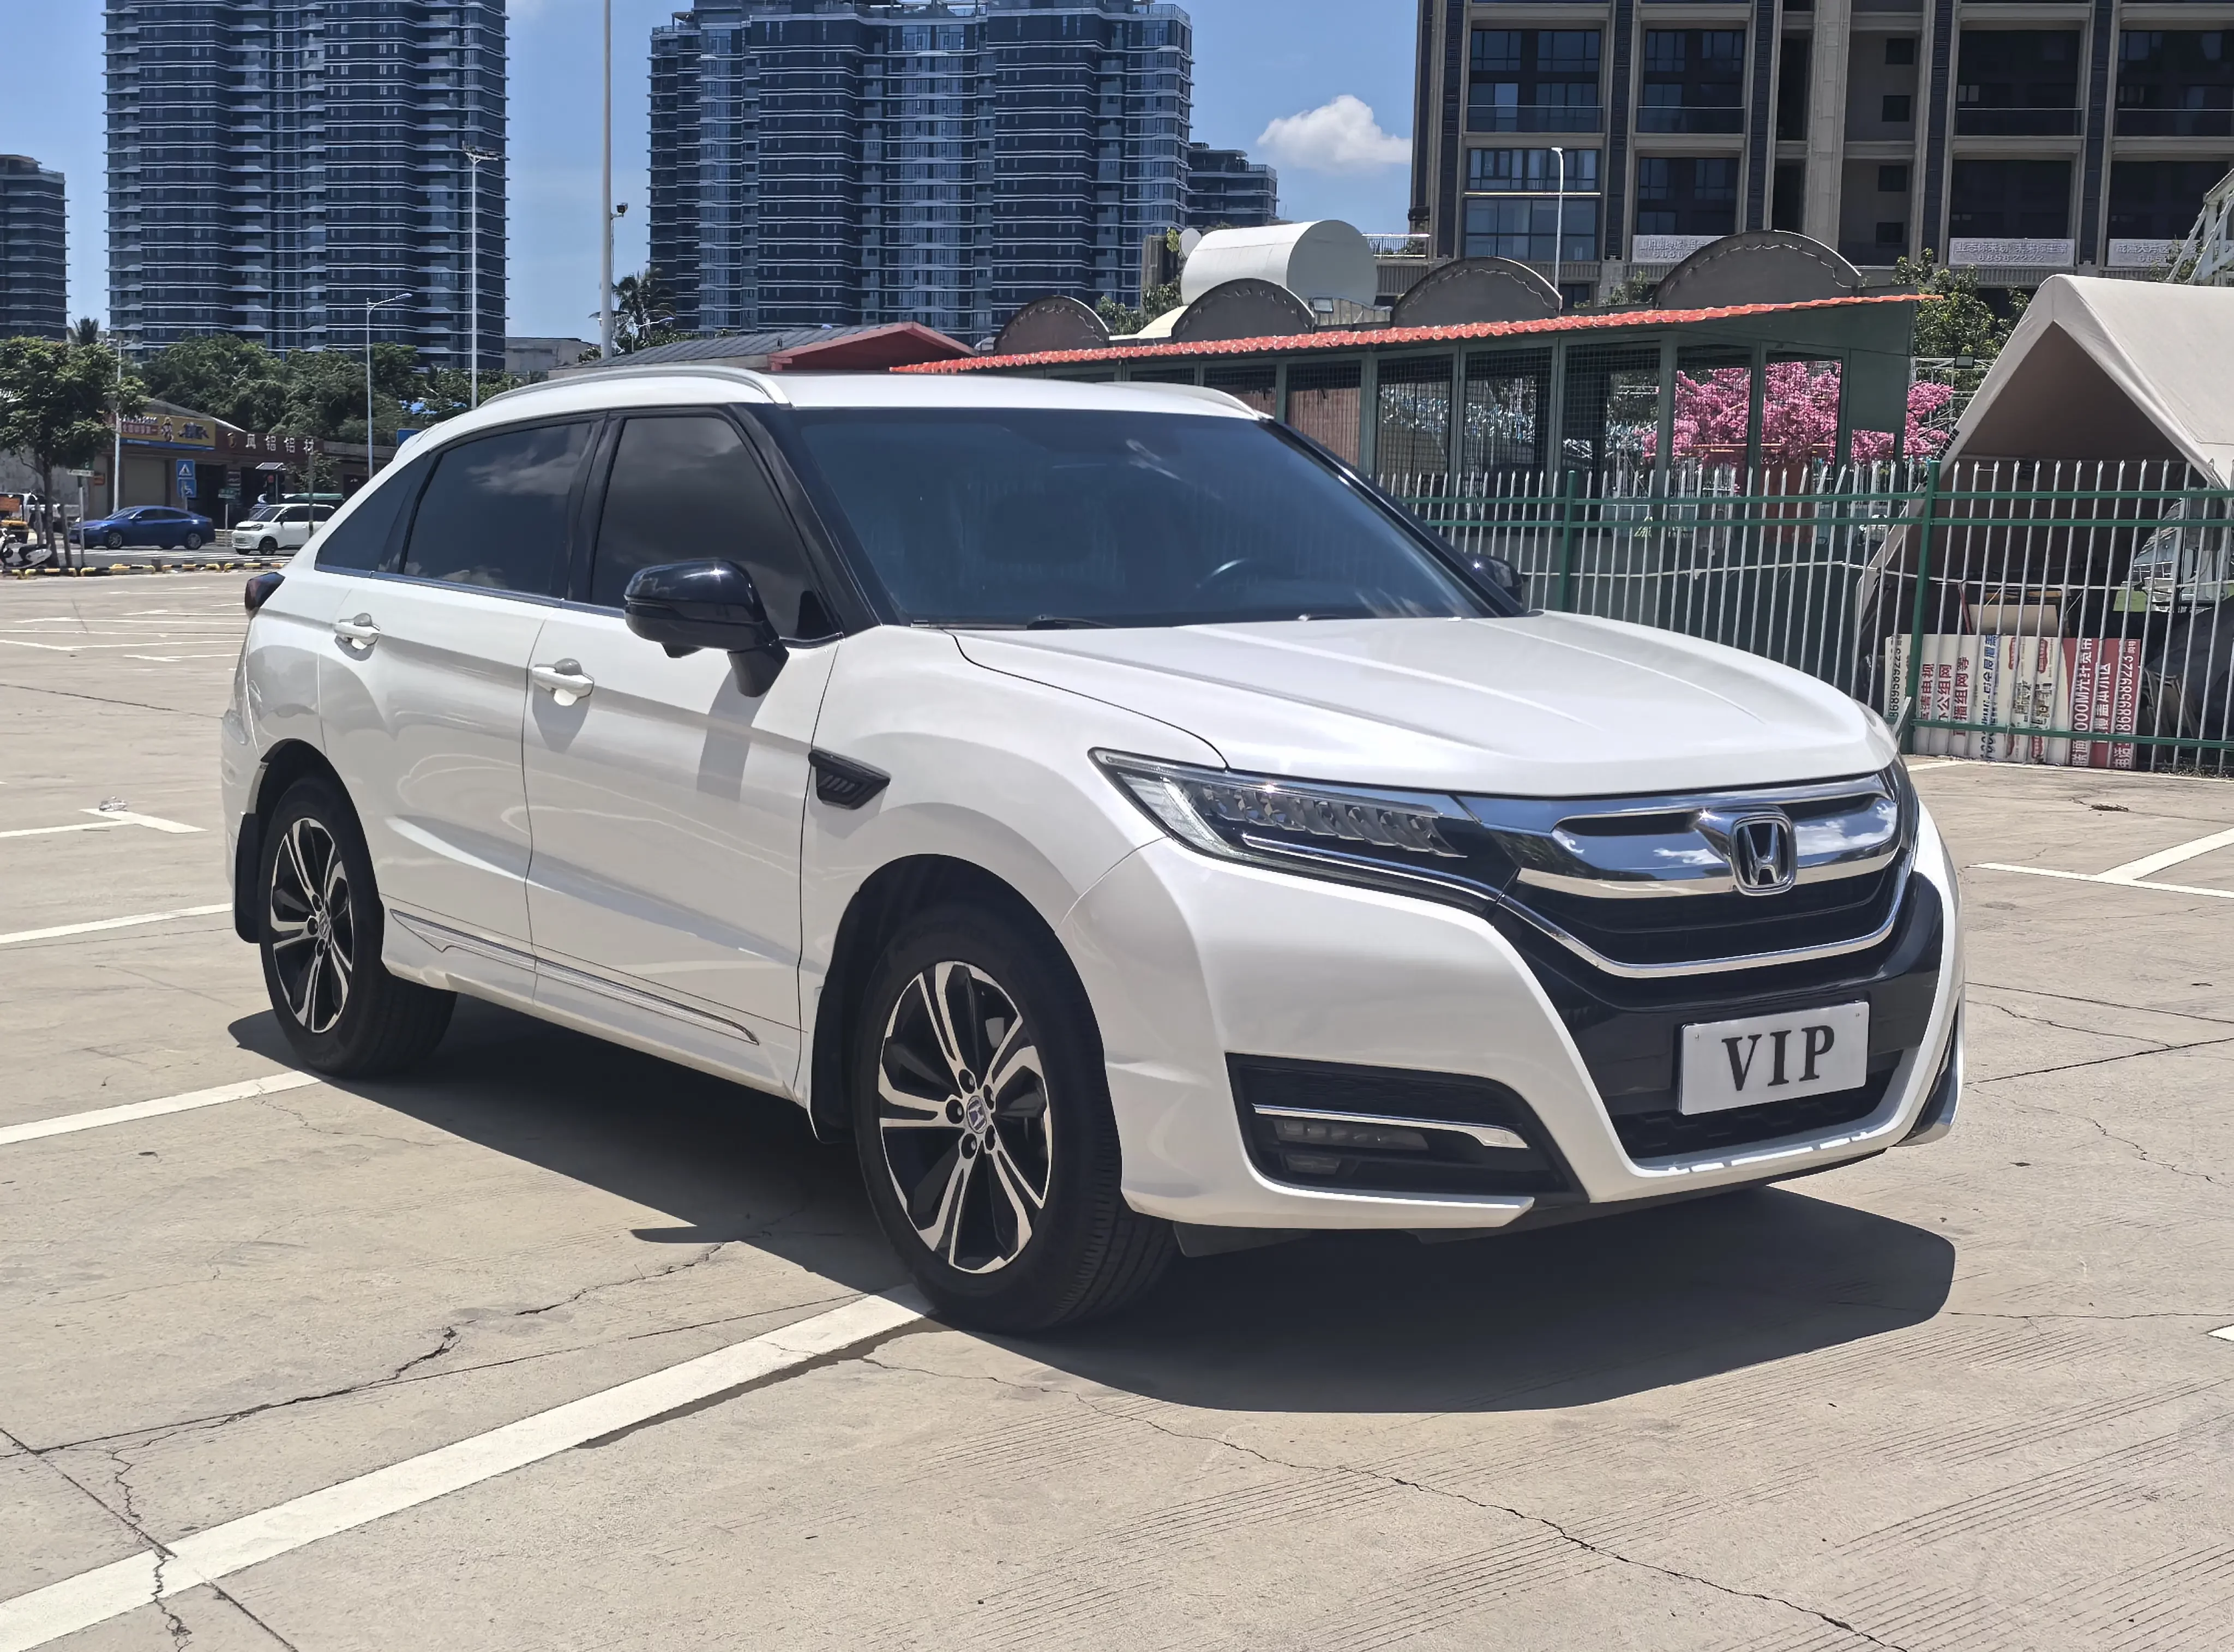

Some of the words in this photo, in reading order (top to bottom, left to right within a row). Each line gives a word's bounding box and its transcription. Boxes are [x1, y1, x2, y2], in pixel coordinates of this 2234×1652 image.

[1888, 647, 1902, 717] 8689589223
[2092, 663, 2111, 743] 覆盖本小区
[1721, 1024, 1836, 1092] VIP
